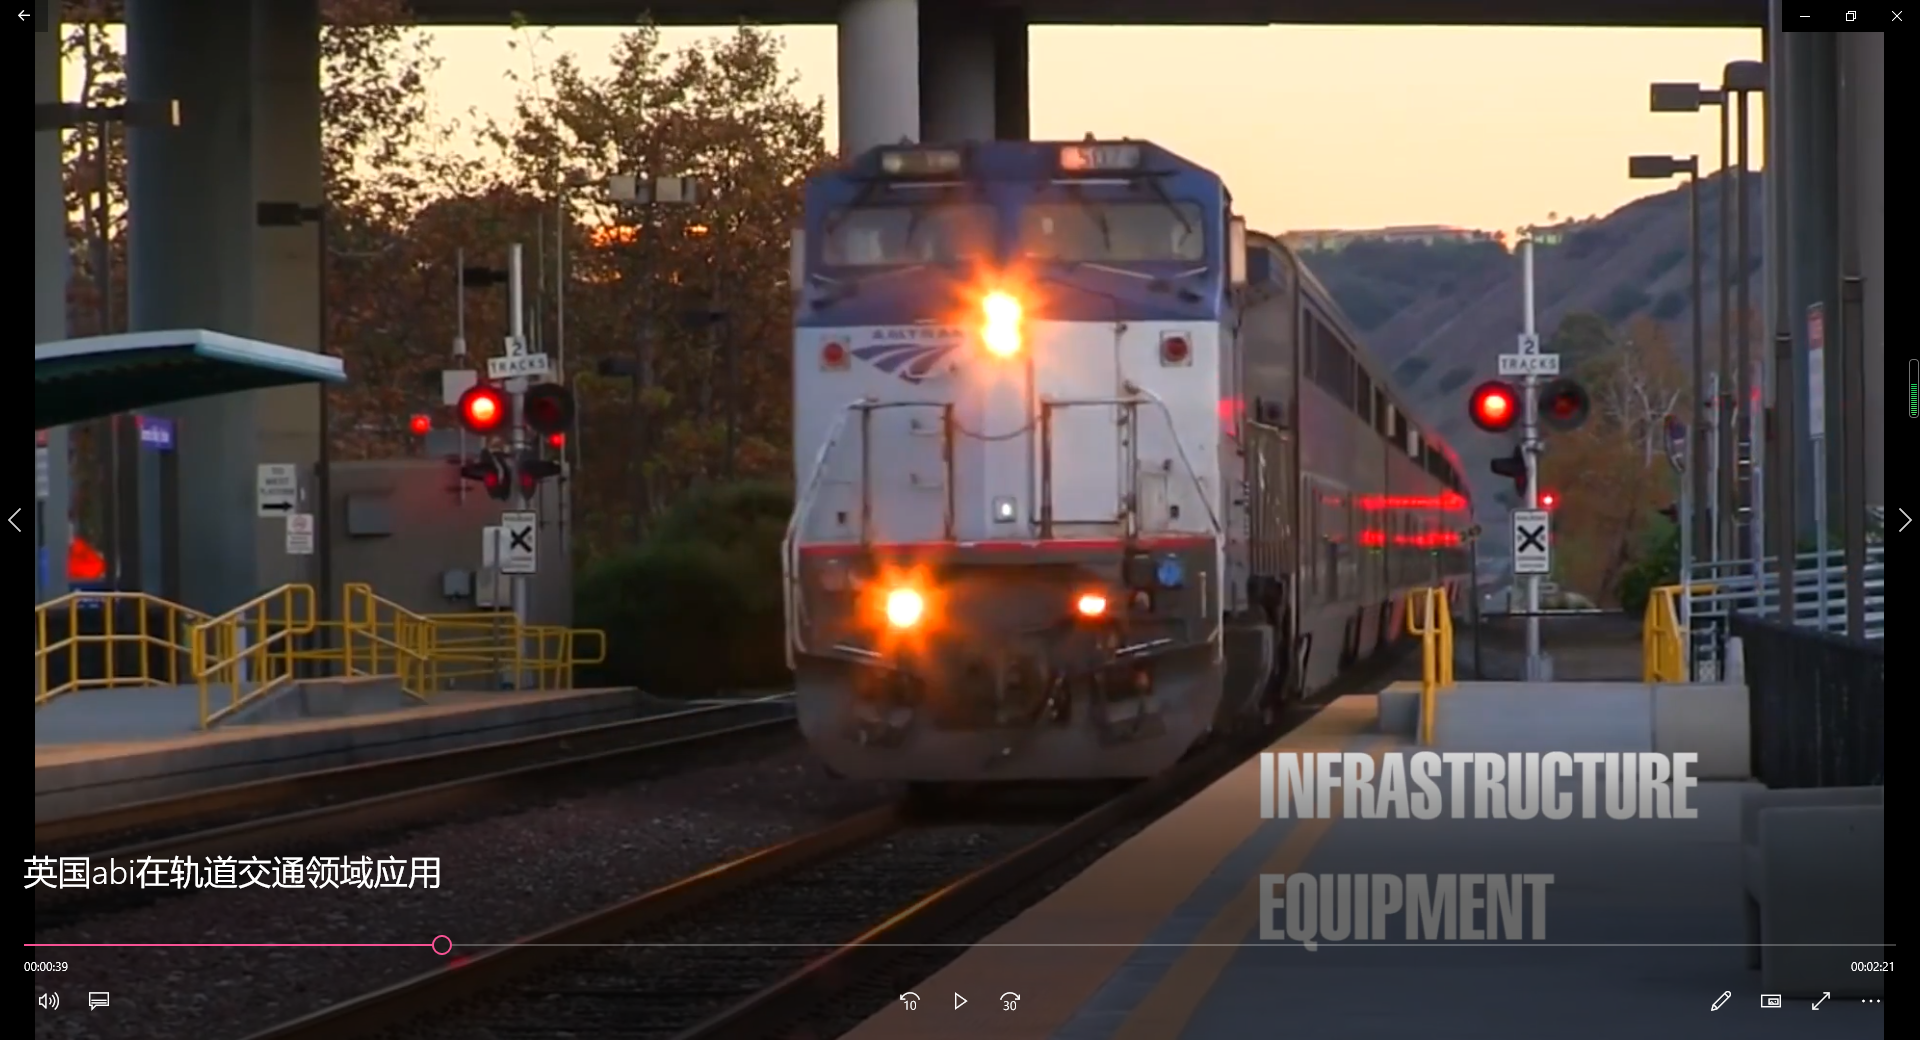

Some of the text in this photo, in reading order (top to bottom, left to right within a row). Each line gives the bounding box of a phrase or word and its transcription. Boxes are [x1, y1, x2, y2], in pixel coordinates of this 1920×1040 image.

[511, 342, 522, 356] 2
[1523, 339, 1535, 355] 2
[490, 357, 546, 374] TRACKS
[1501, 357, 1557, 370] TRACKS
